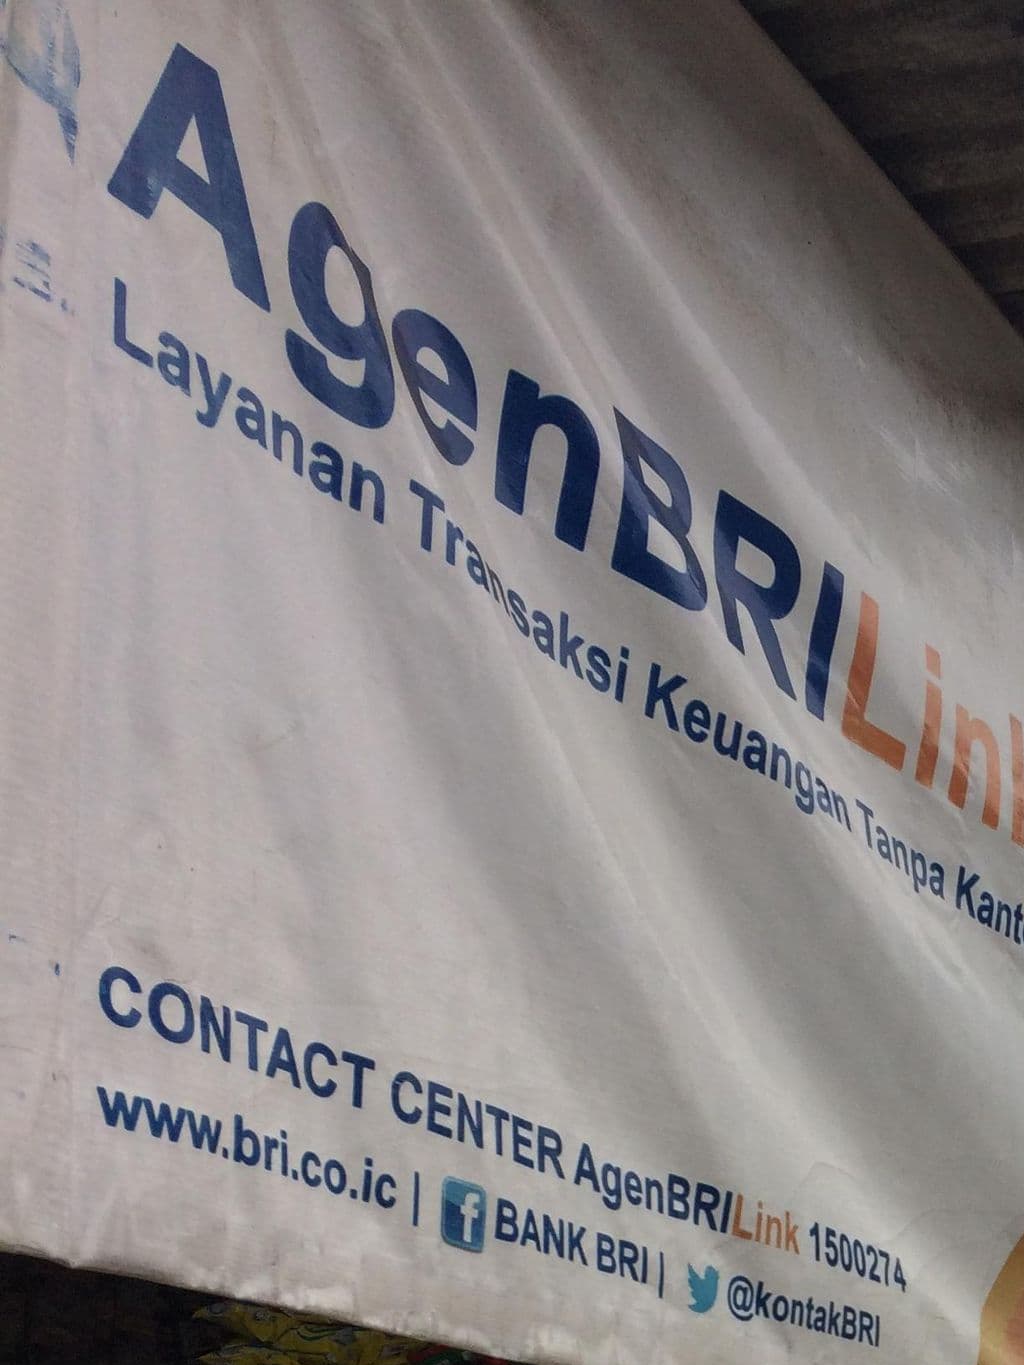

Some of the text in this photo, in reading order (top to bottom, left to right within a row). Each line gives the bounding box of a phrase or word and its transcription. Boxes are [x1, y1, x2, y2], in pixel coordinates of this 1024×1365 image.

[113, 276, 386, 524] Layanan
[409, 479, 631, 703] Transaksi
[643, 661, 852, 832] Keuangan
[855, 797, 946, 900] Tanpa
[99, 966, 907, 1293] CONTACT CENTER AgenBRILink 1500274
[493, 1197, 589, 1267] BANK
[596, 1231, 649, 1285] BRI
[727, 1275, 881, 1348] @kontakBRI
